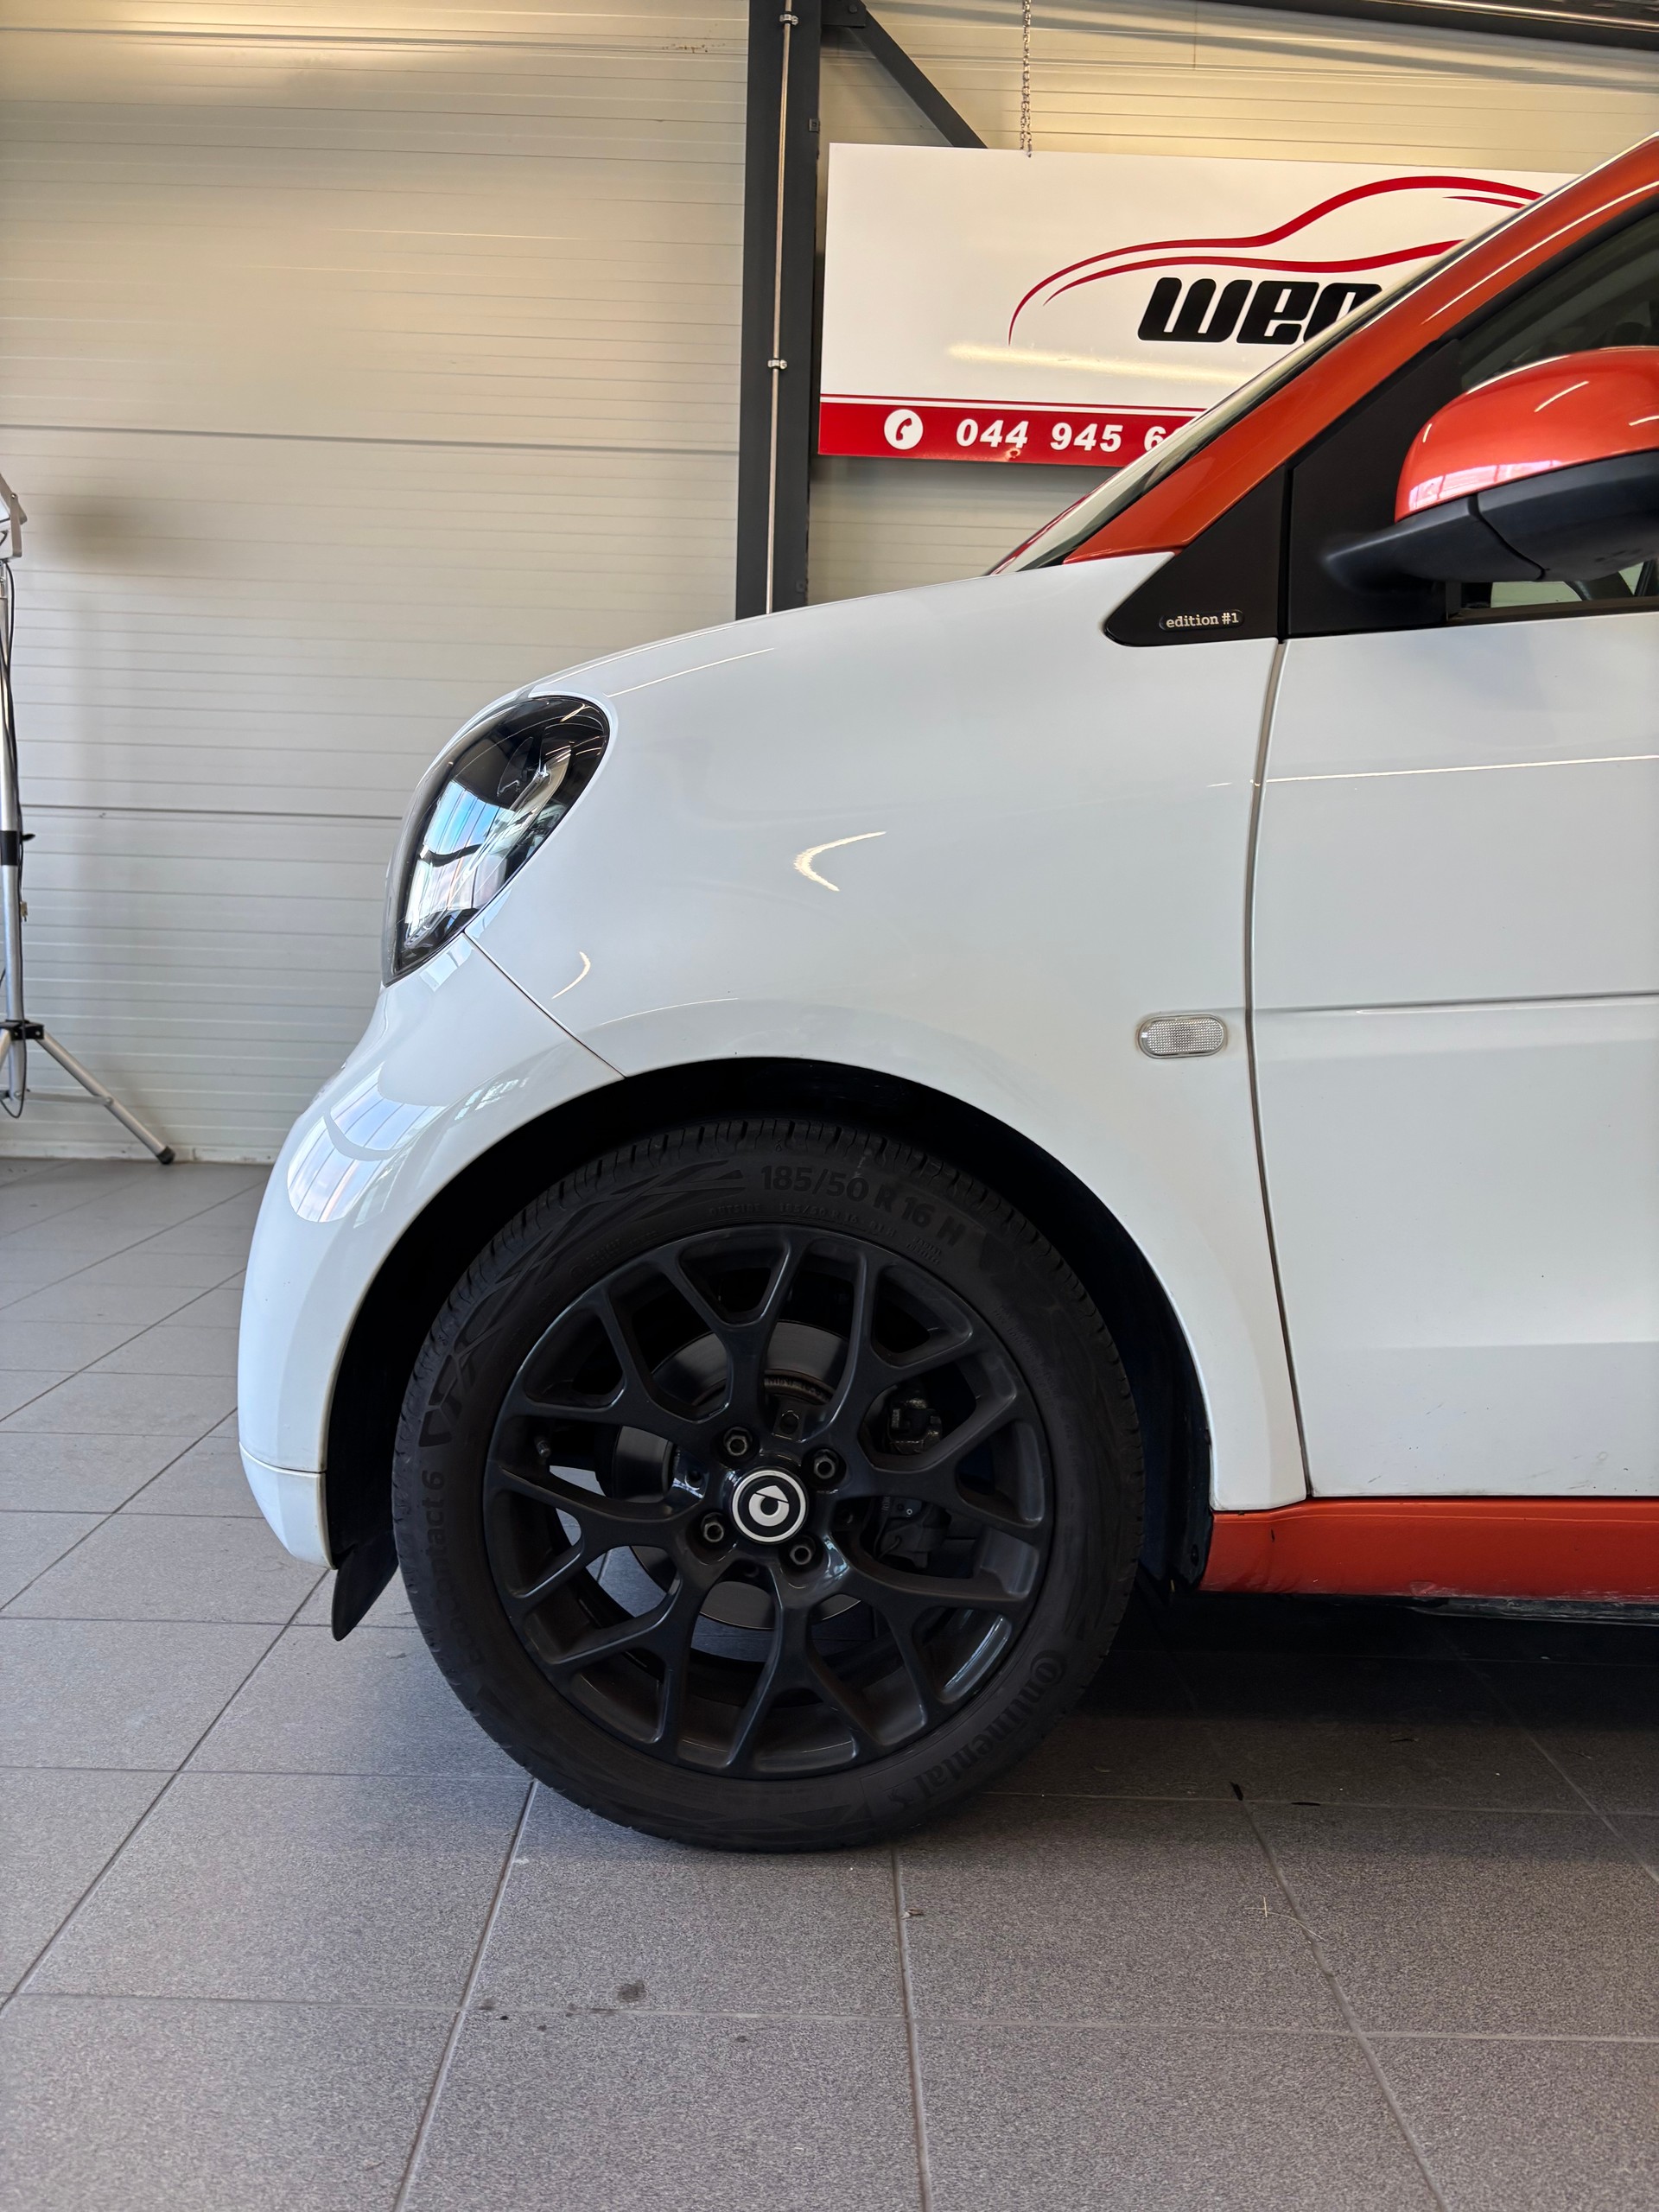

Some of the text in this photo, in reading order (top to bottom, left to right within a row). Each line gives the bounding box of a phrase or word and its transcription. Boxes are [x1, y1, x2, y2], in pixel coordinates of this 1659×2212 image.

[956, 418, 1181, 452] 044 945 6
[1166, 612, 1239, 628] edition #1
[760, 1166, 869, 1202] 185/50
[873, 1184, 899, 1213] R
[901, 1196, 933, 1228] 16
[912, 1649, 1068, 1799] Continental
